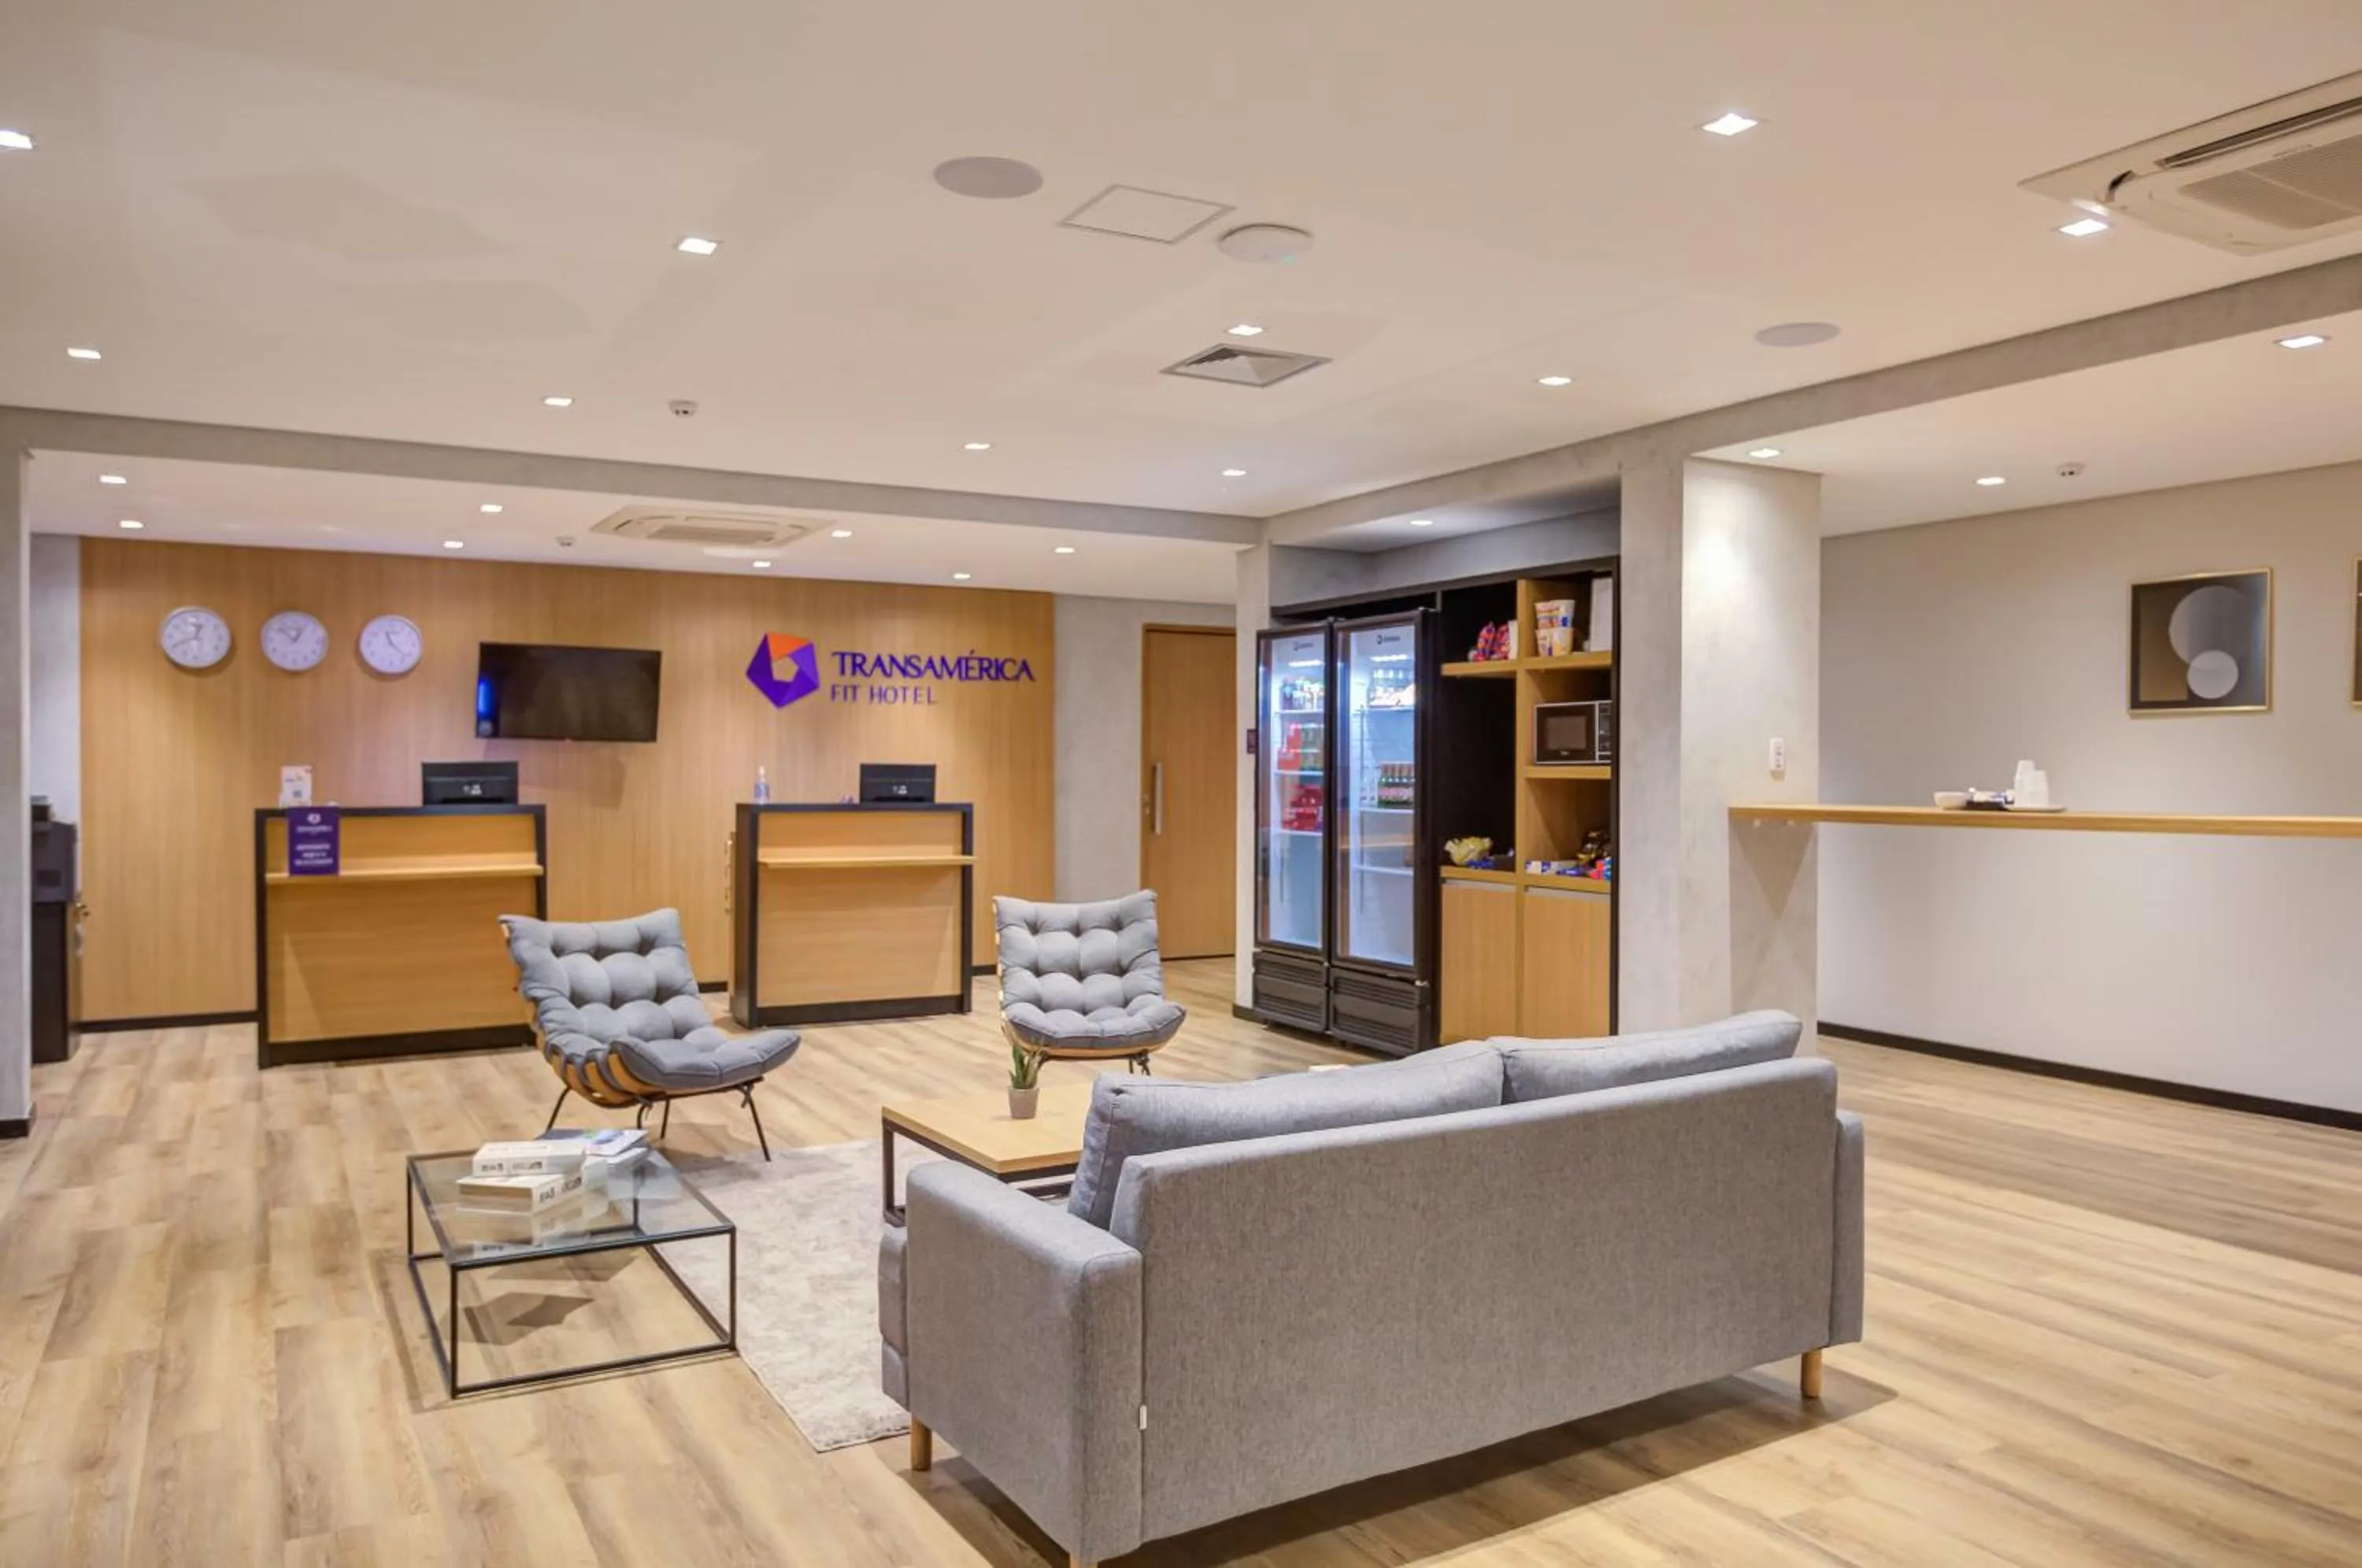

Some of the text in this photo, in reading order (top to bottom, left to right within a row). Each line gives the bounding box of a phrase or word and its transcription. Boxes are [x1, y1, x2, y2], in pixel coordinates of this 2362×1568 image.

[831, 649, 1035, 682] TRANSAMÉRICA
[831, 684, 938, 704] FIT HOTEL
